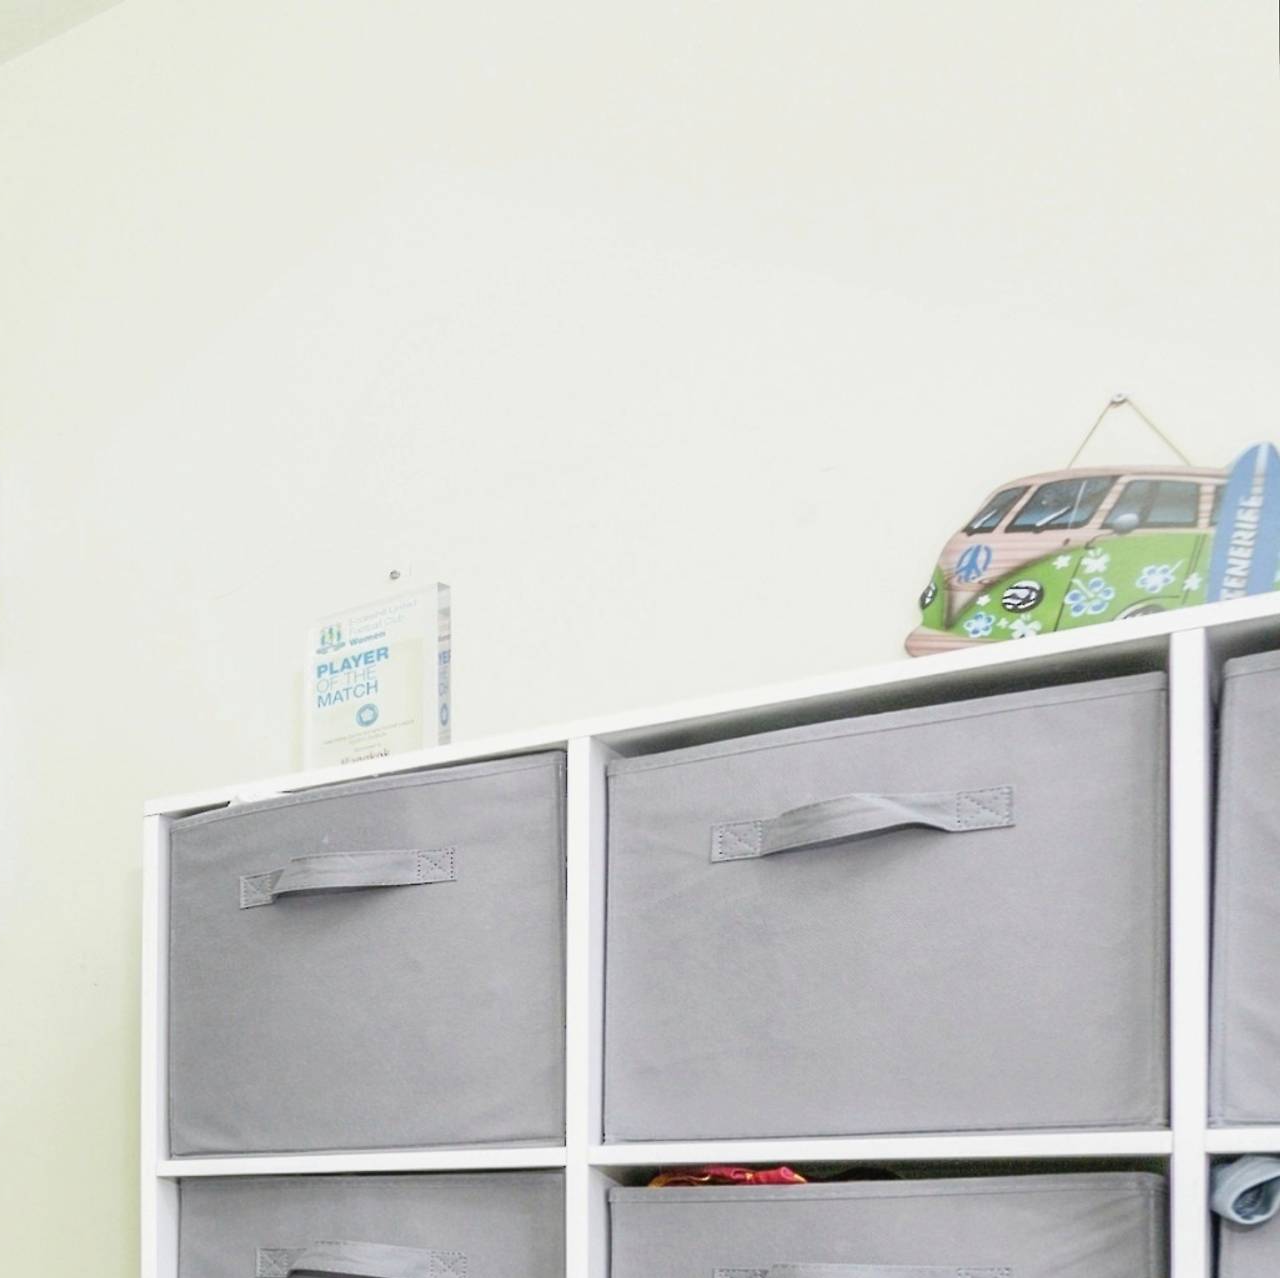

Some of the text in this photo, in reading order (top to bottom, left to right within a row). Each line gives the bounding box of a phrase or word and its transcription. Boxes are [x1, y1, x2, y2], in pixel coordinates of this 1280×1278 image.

[316, 646, 389, 679] PLAYER
[316, 664, 378, 693] OF THE
[316, 681, 379, 709] MATCH
